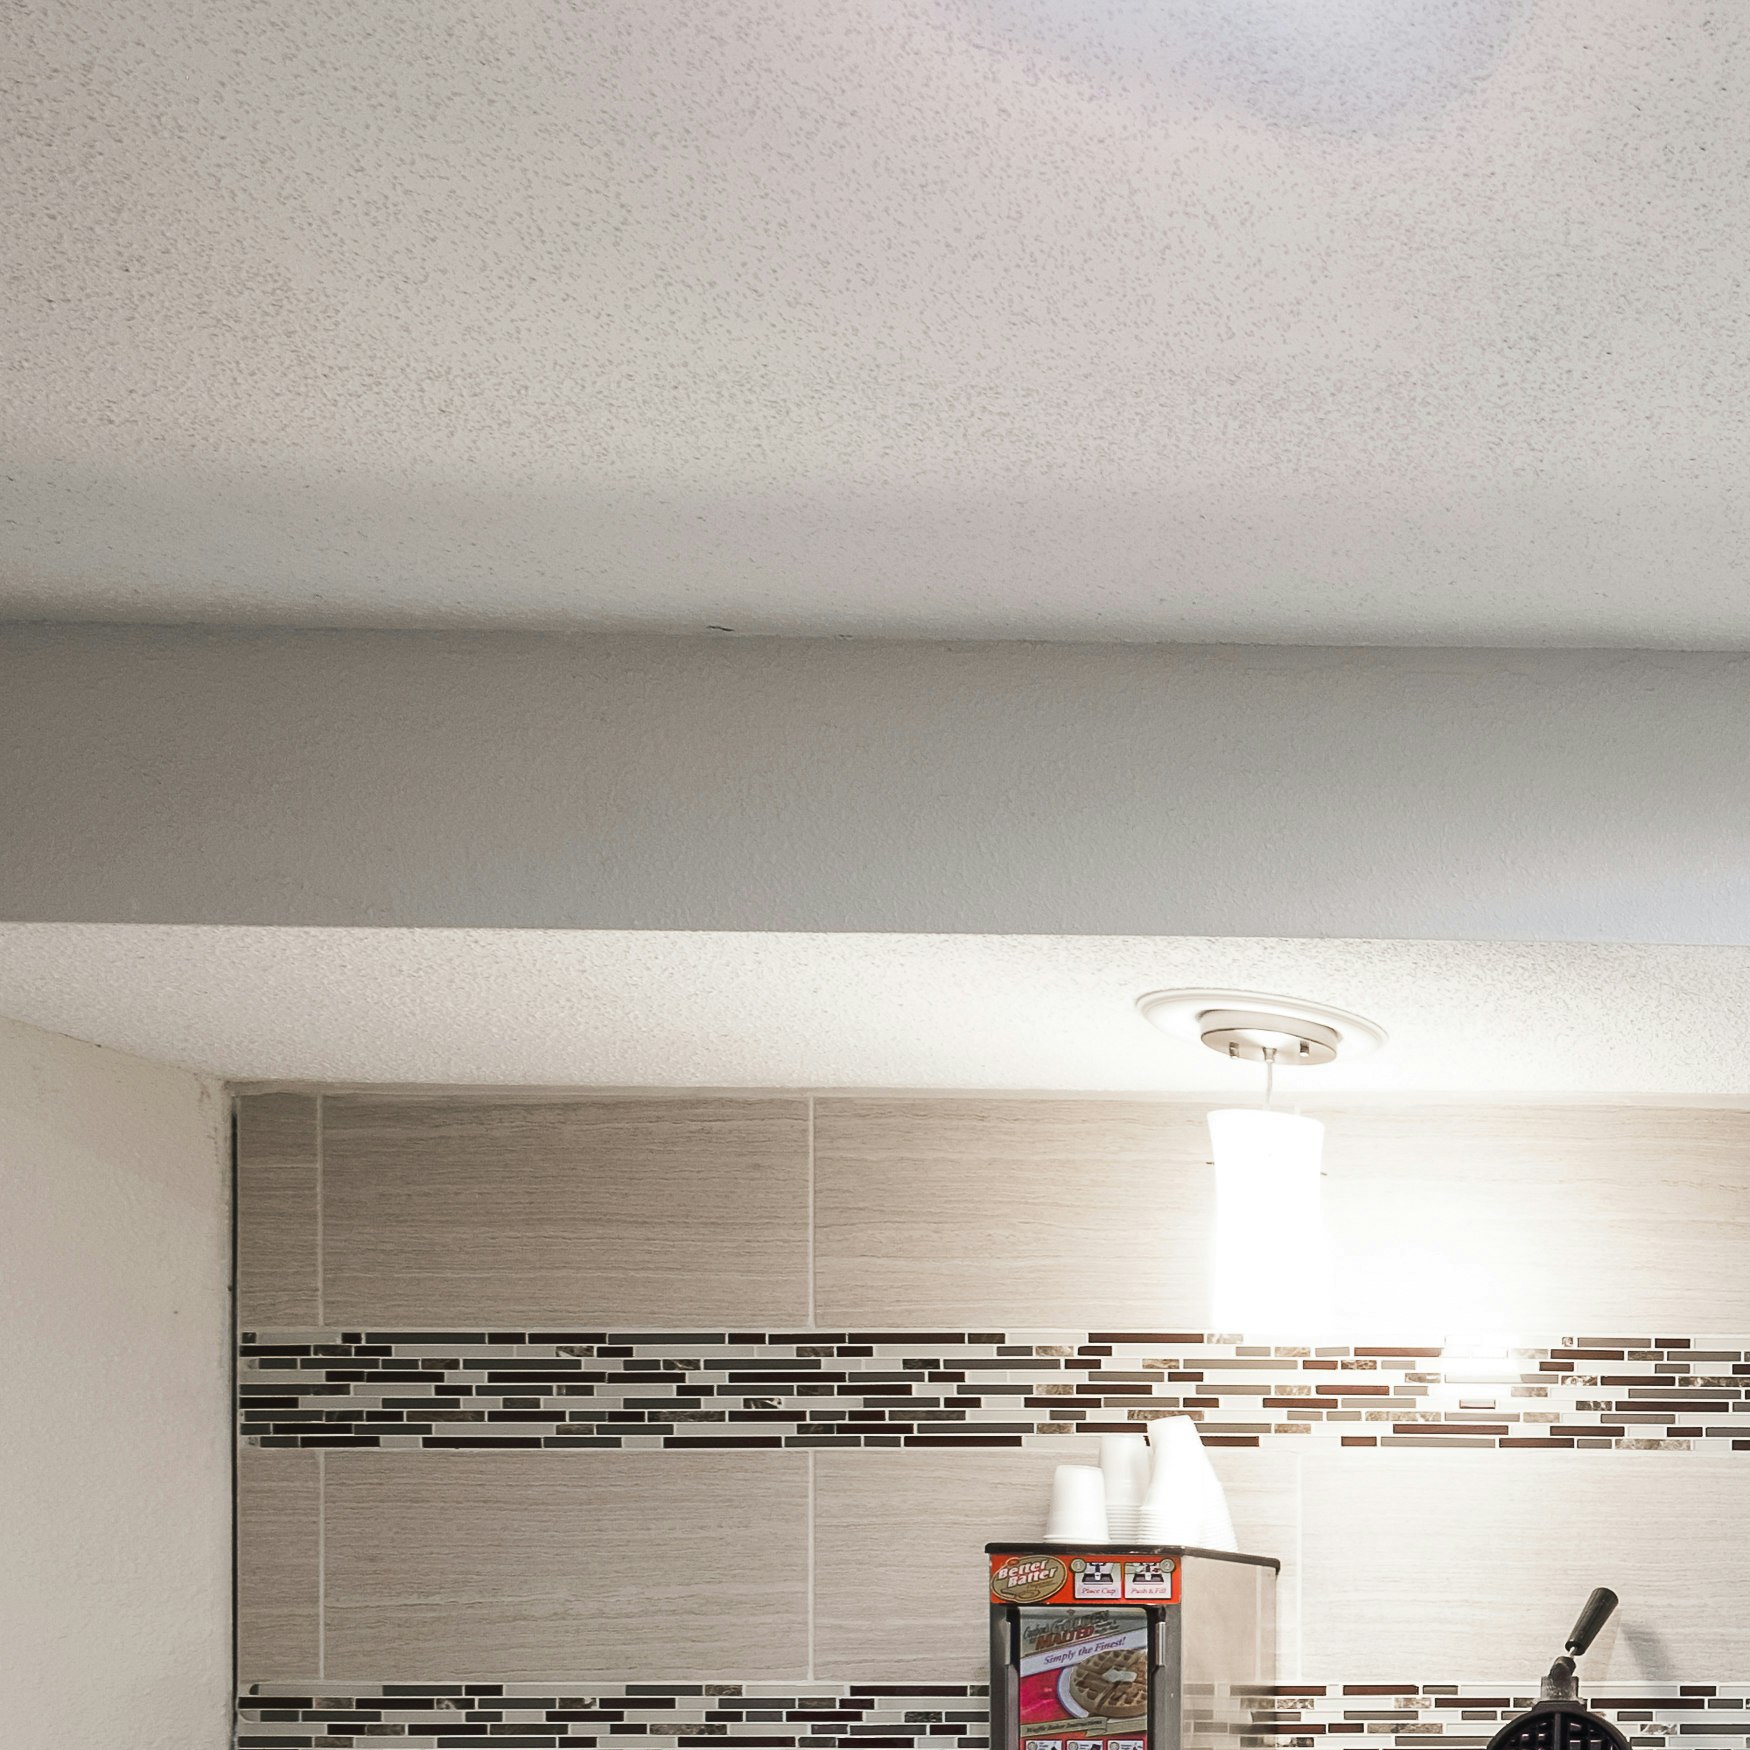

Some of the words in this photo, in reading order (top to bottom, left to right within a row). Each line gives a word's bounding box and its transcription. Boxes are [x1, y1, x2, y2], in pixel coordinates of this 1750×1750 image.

[998, 1560, 1047, 1580] Better
[1007, 1567, 1059, 1588] Batter
[1100, 1588, 1117, 1596] Cup
[1035, 1625, 1096, 1650] MALTED
[1043, 1649, 1076, 1665] Simply
[1078, 1645, 1093, 1656] the
[1093, 1636, 1127, 1652] Finest!
